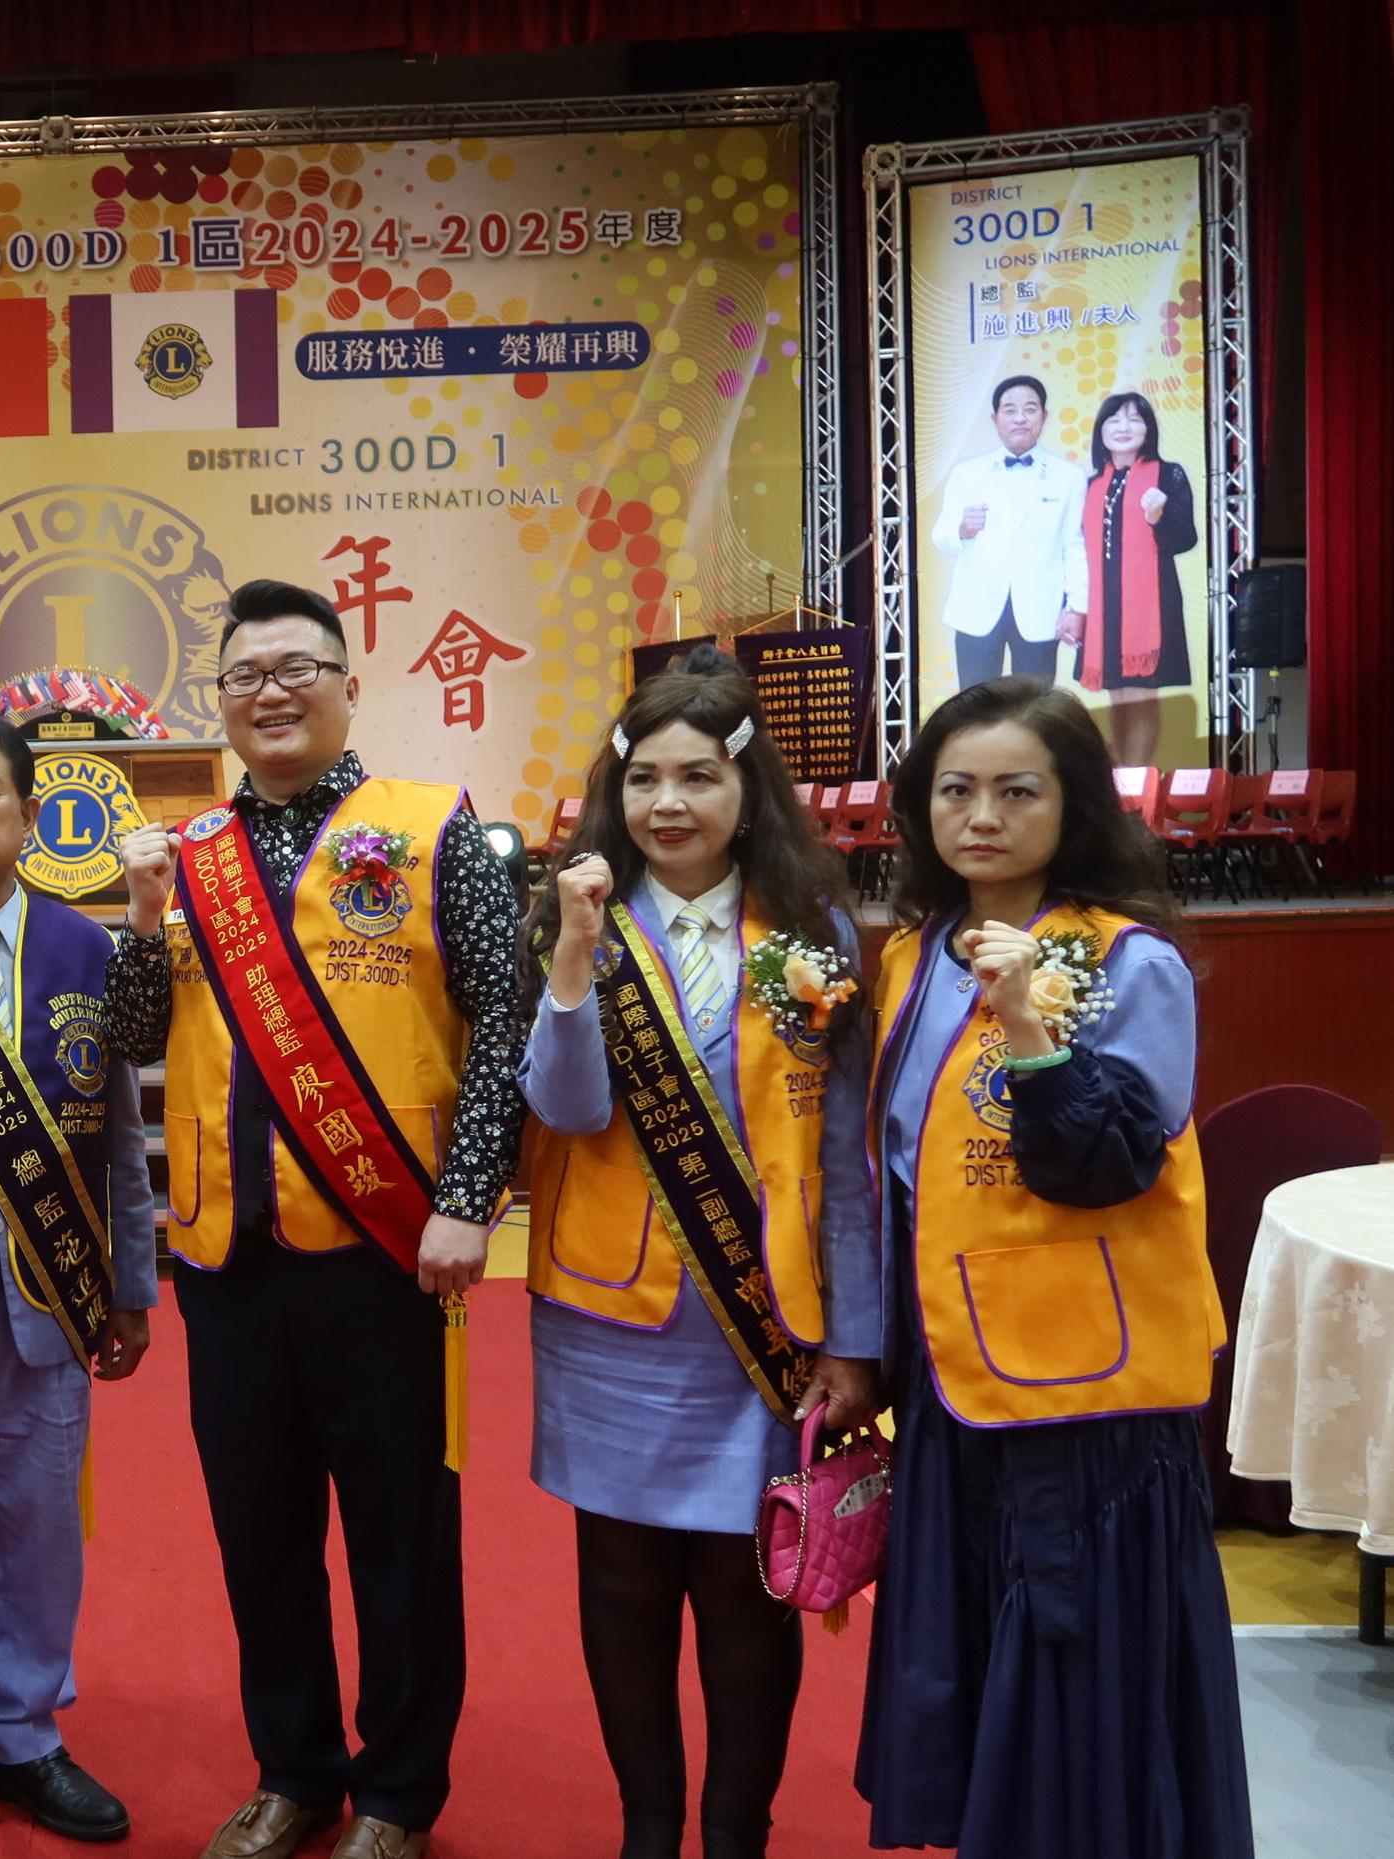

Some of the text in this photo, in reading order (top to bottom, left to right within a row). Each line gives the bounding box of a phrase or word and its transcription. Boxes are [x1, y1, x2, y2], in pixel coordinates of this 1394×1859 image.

[951, 185, 1023, 205] DISTRICT
[953, 203, 1094, 246] 300D 1
[986, 239, 1181, 270] LIONS INTERNATIONAL
[151, 326, 196, 343] LIONS
[166, 347, 185, 373] L
[307, 327, 640, 375] 服務悅進 榮耀再興
[187, 433, 507, 474] DISTRICT 300D 1
[251, 487, 561, 516] LIONS INTERNATIONAL
[34, 761, 112, 791] LIONS
[56, 800, 92, 845] L
[30, 857, 111, 882] INTERNATIONAL
[215, 833, 253, 916] 國際獅子會
[218, 913, 259, 944] 2024
[348, 917, 396, 932] INTERNATIONAL
[225, 931, 267, 963] 2025
[328, 940, 413, 965] 2024-2025
[48, 992, 105, 1012] DISTRICT
[245, 963, 304, 1058] 助理總監
[66, 1023, 104, 1043] LIONS
[616, 982, 681, 1098] 國際獅子會
[78, 1043, 96, 1071] L
[642, 1099, 692, 1131] 2024
[653, 1122, 705, 1154] 2025
